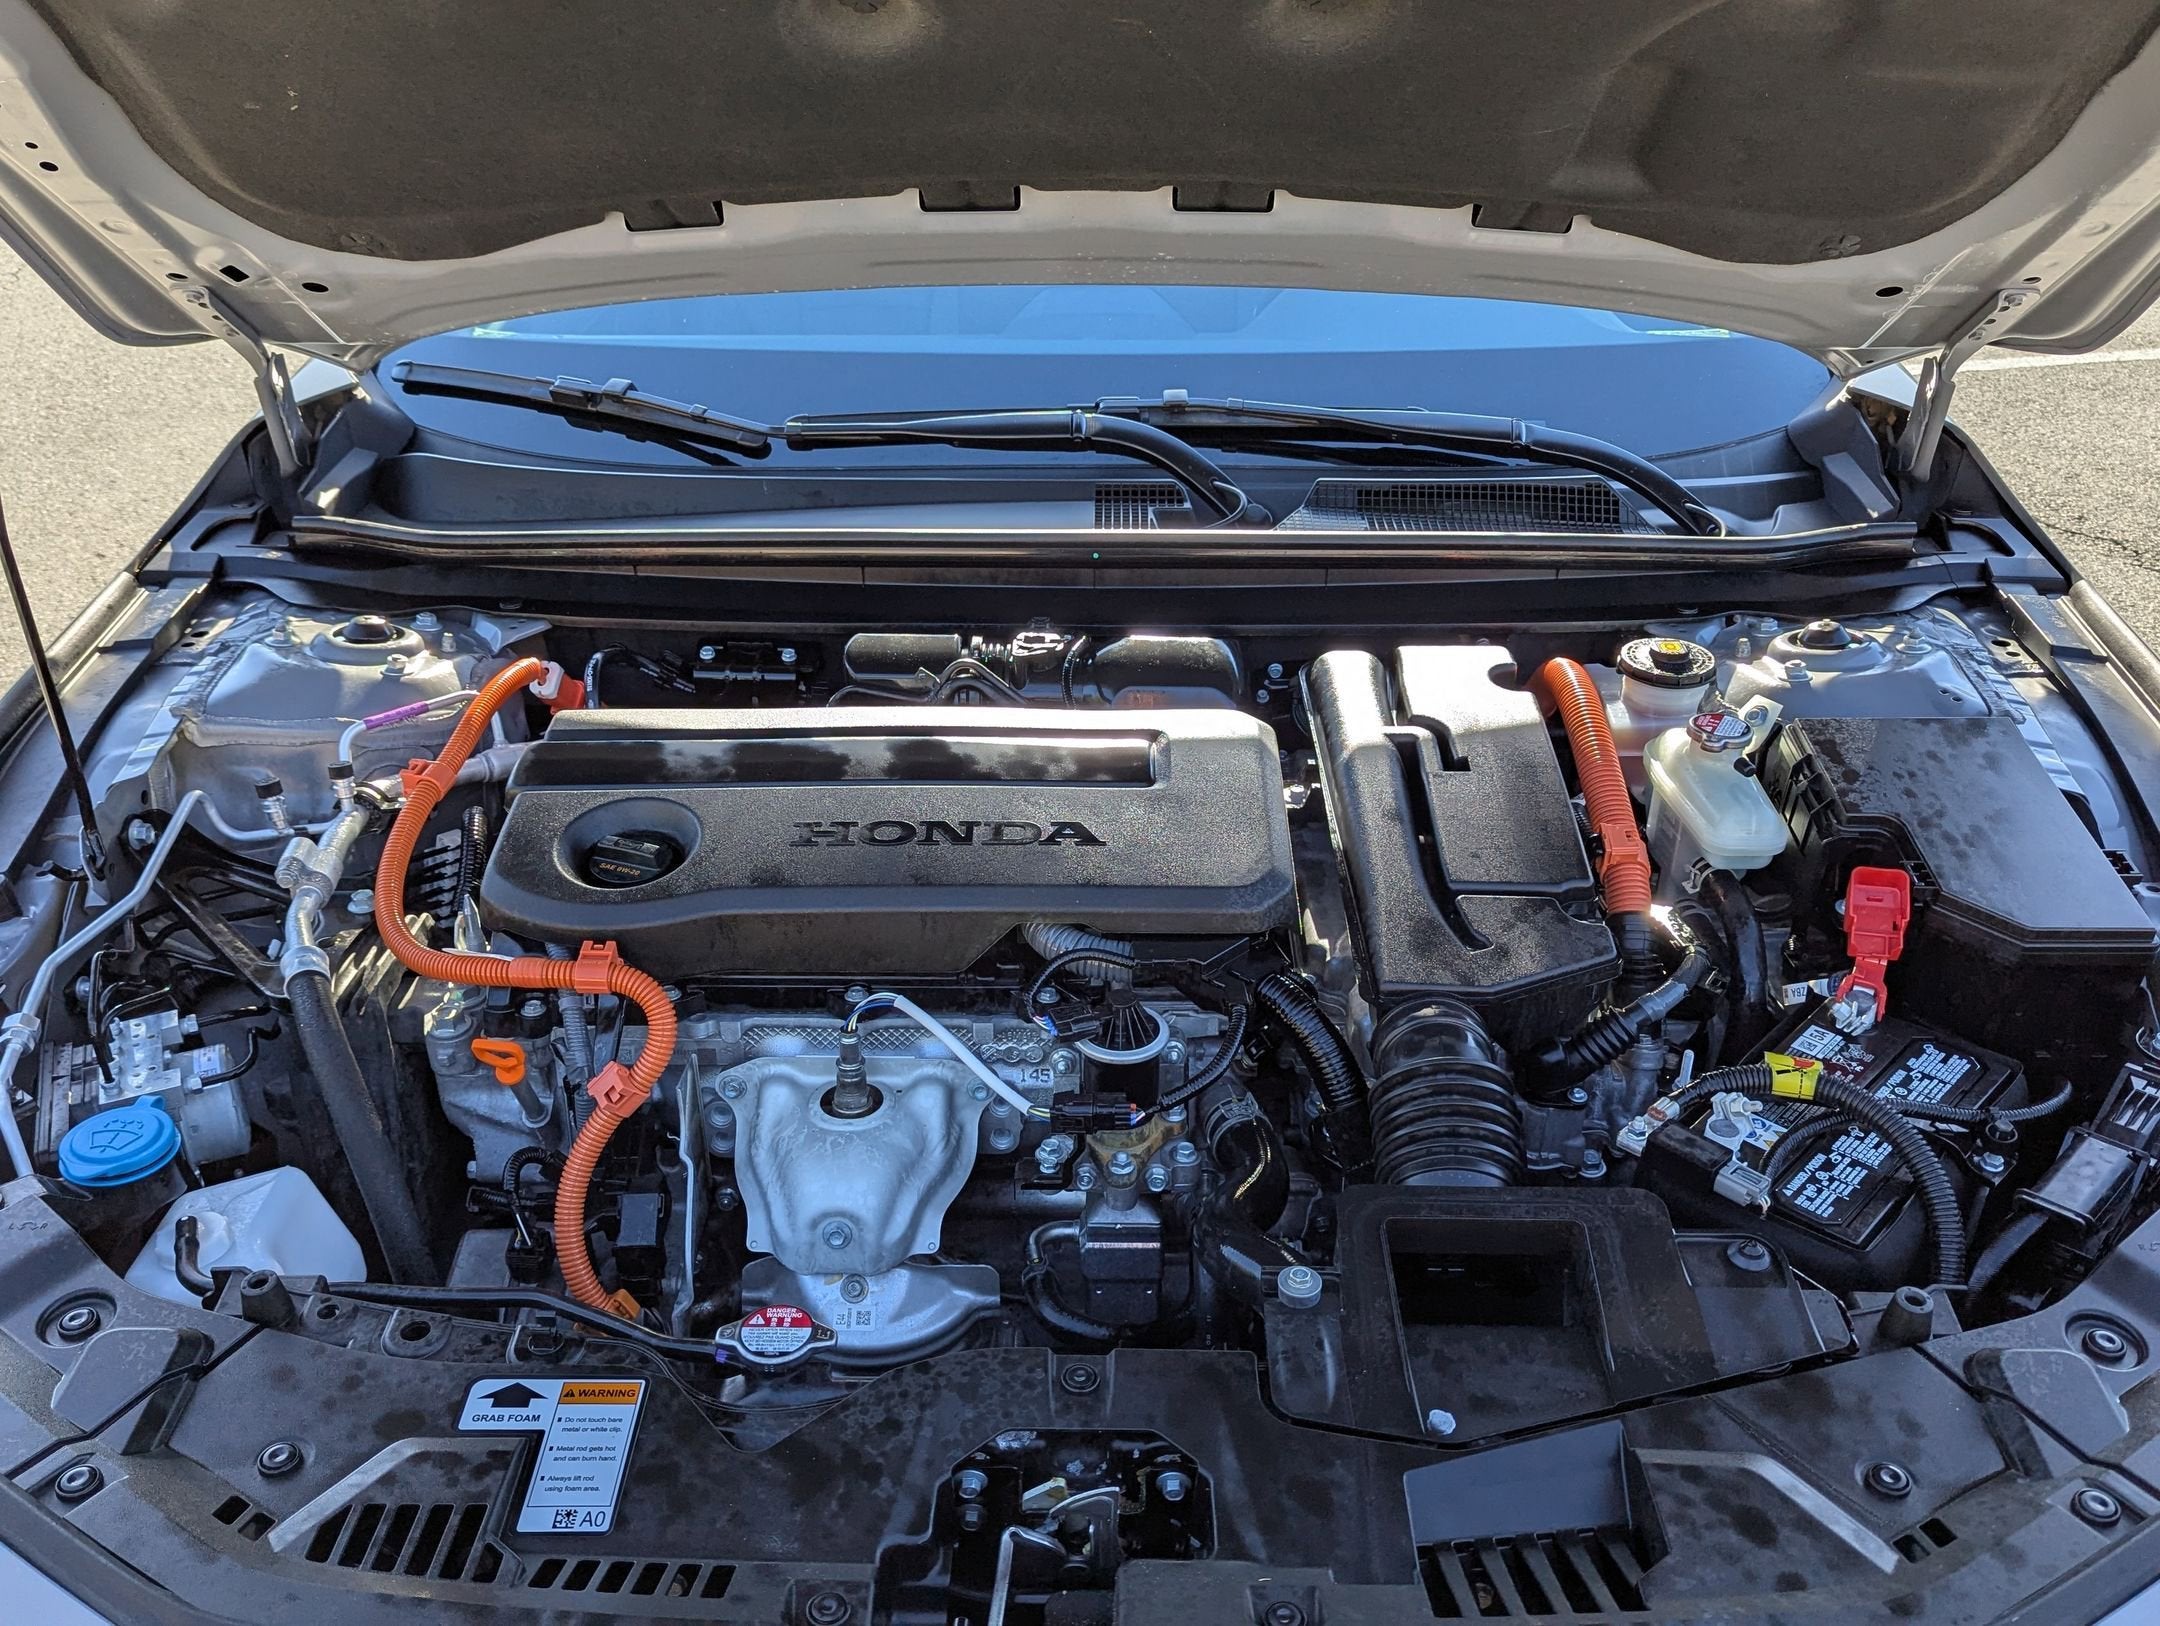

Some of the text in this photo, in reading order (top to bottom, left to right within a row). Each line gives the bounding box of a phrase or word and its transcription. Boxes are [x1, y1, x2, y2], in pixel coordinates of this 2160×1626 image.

[790, 819, 1107, 847] HONDA
[599, 862, 640, 876] SAE 0W-20
[1810, 1028, 1830, 1042] 5A
[1020, 1068, 1051, 1083] 145
[578, 1389, 636, 1398] WARNING
[472, 1413, 541, 1423] GRAB FOAM
[609, 1426, 623, 1434] clip.
[588, 1446, 604, 1454] gets
[547, 1475, 571, 1483] Always
[544, 1486, 563, 1494] using
[564, 1485, 582, 1493] foam
[579, 1510, 606, 1528] A0
